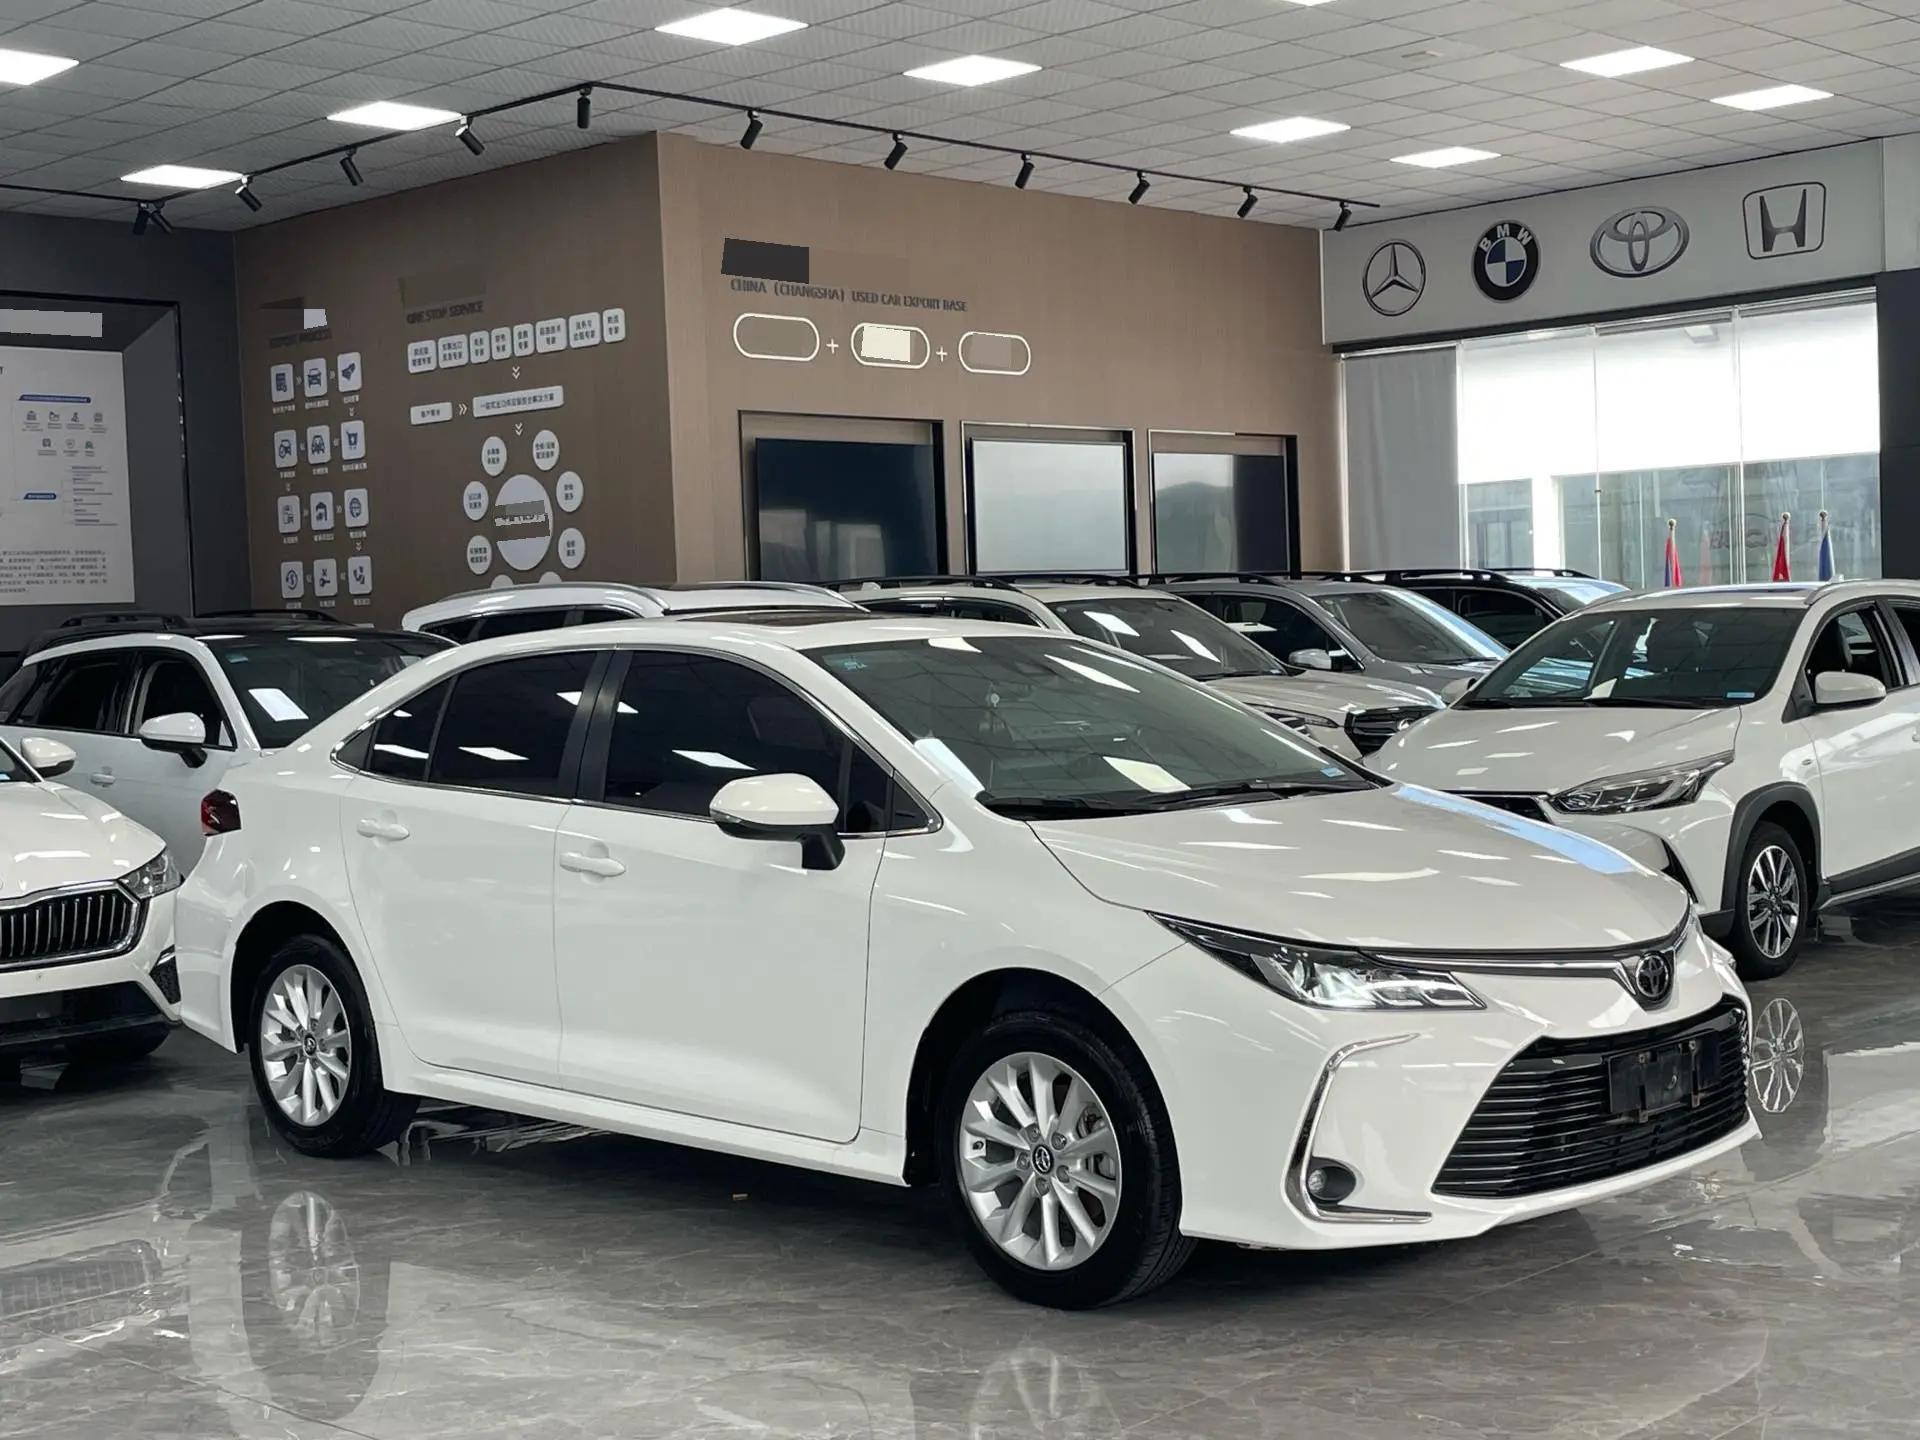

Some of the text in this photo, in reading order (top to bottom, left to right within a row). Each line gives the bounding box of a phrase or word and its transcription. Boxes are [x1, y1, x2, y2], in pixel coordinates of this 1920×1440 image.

[1479, 223, 1533, 252] BMW
[730, 278, 767, 294] CHINA
[851, 290, 879, 304] USED
[881, 293, 901, 307] CAR
[903, 295, 940, 310] EXPORT
[943, 299, 968, 312] BASE
